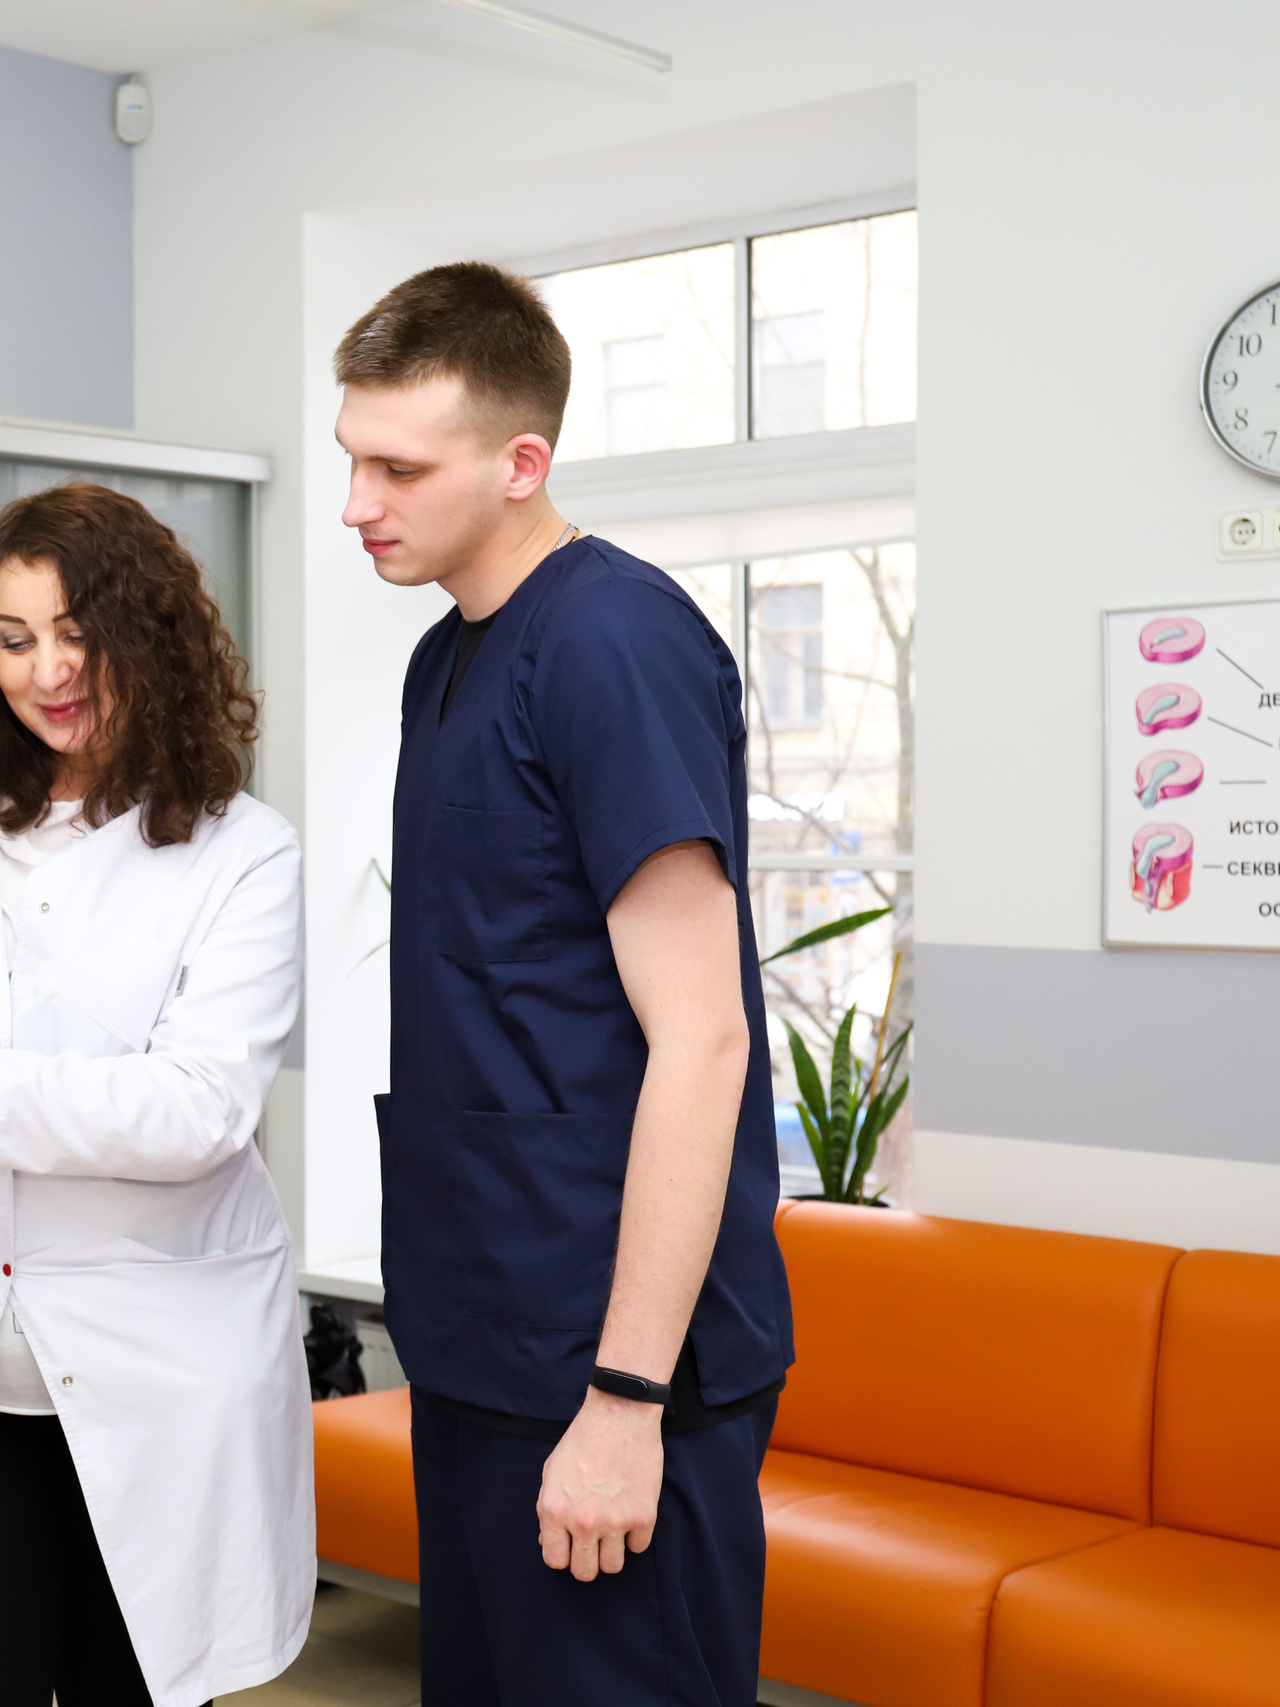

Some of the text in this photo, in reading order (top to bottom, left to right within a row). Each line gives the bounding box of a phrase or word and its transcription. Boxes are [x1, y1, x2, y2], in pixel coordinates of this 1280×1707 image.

[1238, 333, 1262, 356] 10
[1222, 370, 1238, 393] 9
[1234, 408, 1248, 431] 8
[1263, 431, 1277, 454] 7
[1229, 820, 1280, 835] ИСТО
[1227, 860, 1280, 876] СЕКВ
